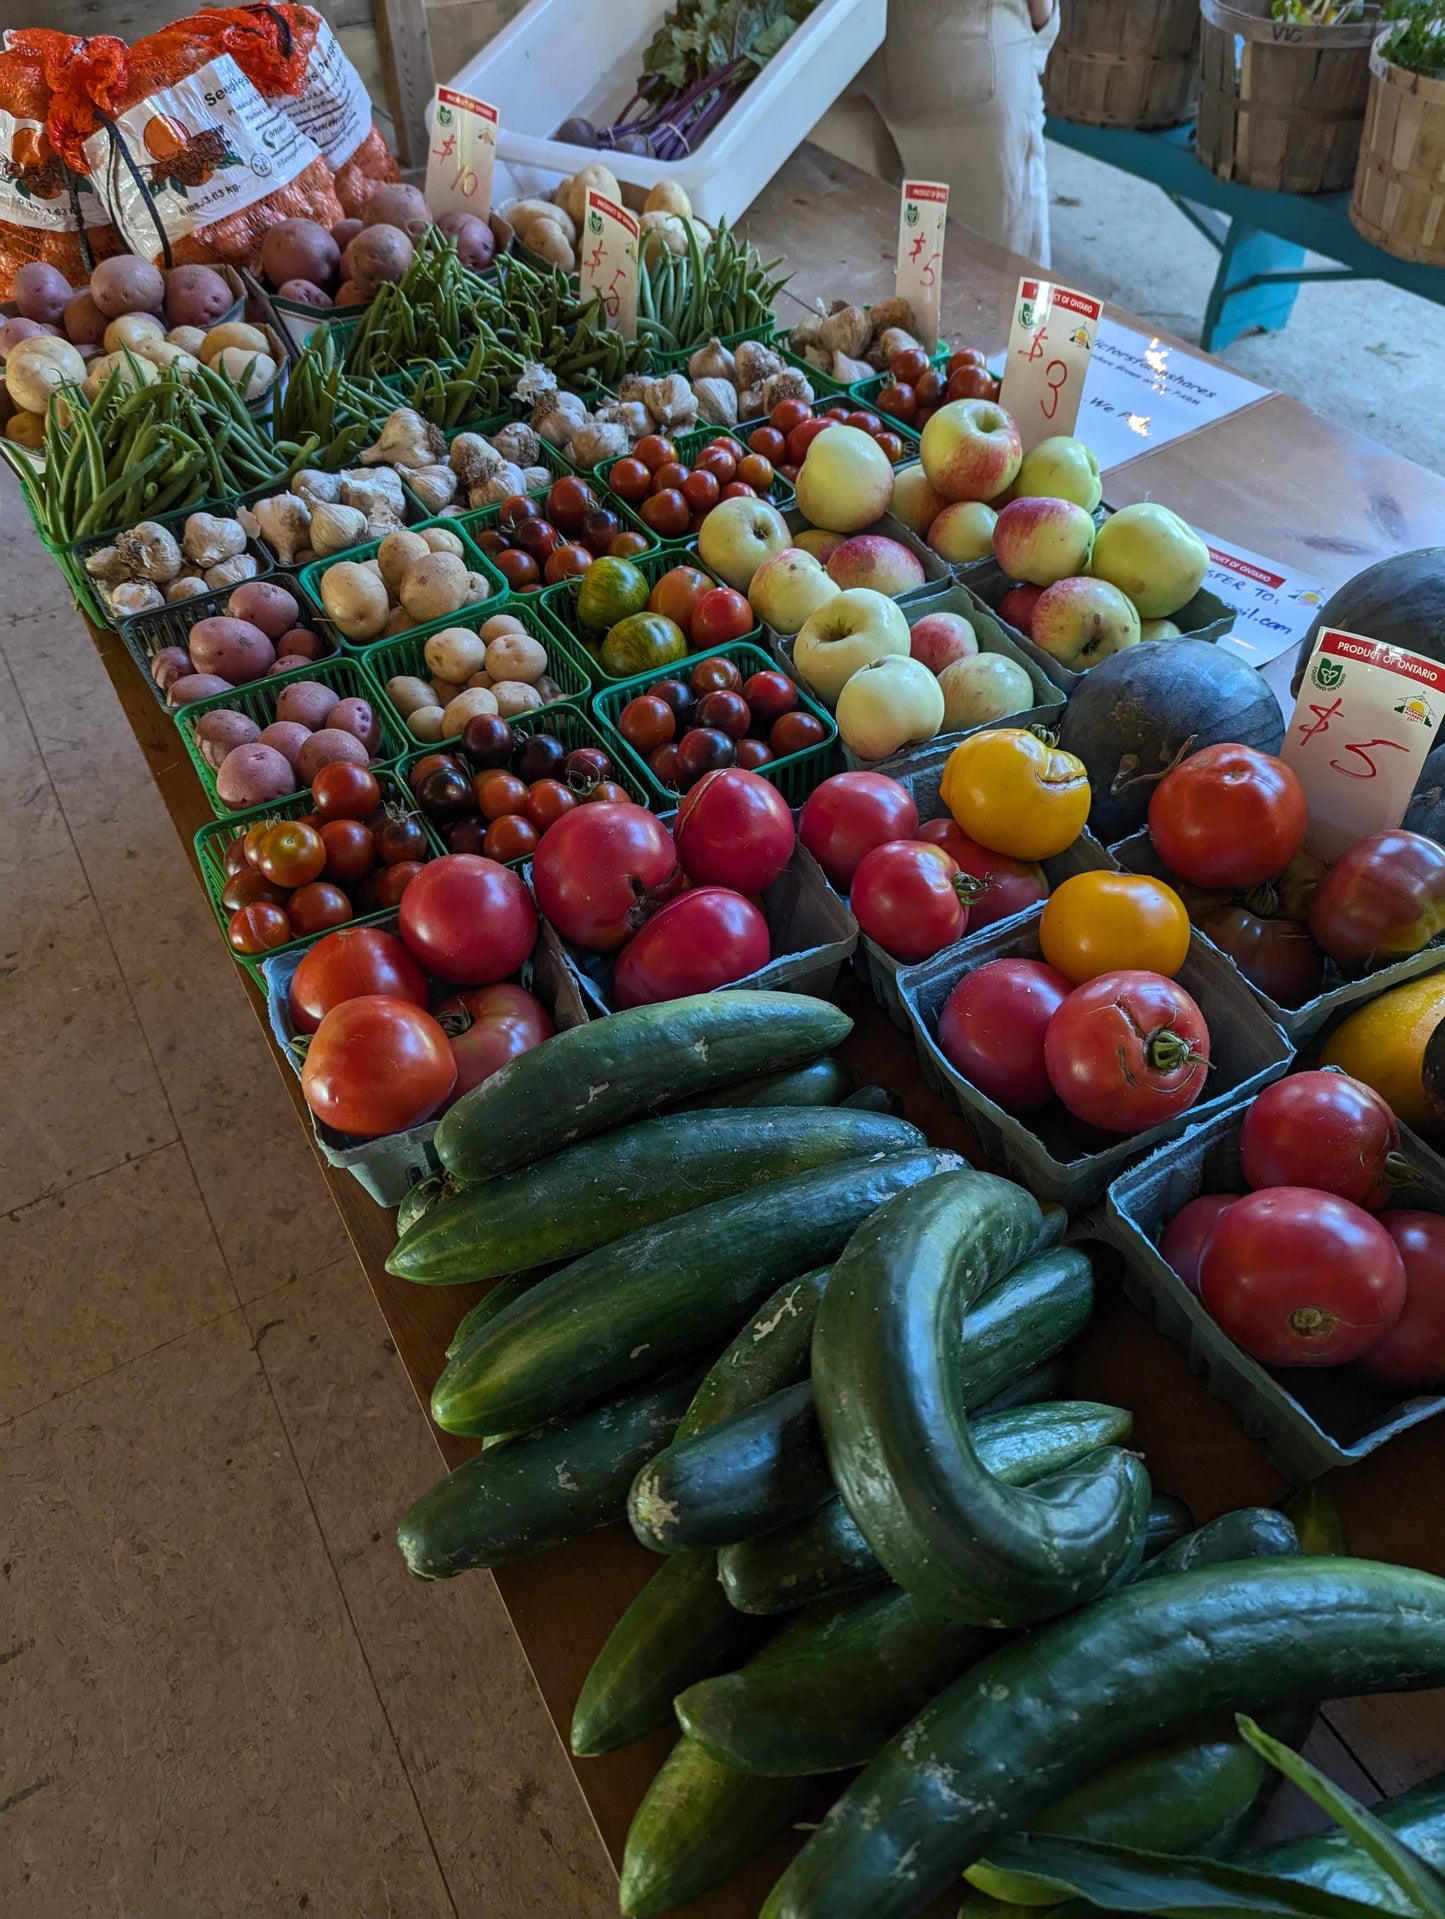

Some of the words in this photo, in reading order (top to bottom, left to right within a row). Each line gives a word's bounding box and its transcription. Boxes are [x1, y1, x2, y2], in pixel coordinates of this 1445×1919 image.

[432, 133, 457, 165] $
[450, 165, 478, 198] 10
[583, 239, 608, 278] $
[606, 268, 626, 318] 5
[908, 232, 926, 264] $
[920, 252, 940, 287] 5
[1061, 296, 1071, 305] OF
[1070, 299, 1093, 314] ONTARIO
[1018, 327, 1049, 363] $
[1040, 360, 1068, 419] 3
[1240, 565, 1272, 583] ONTARIO
[1254, 587, 1280, 606] TO:
[1326, 672, 1347, 692] ONTARIO
[1337, 641, 1382, 662] PRODUCT
[1382, 654, 1397, 666] OF
[1397, 658, 1438, 683] ONTARIO
[1298, 697, 1345, 747] $
[1329, 738, 1411, 779] 5
